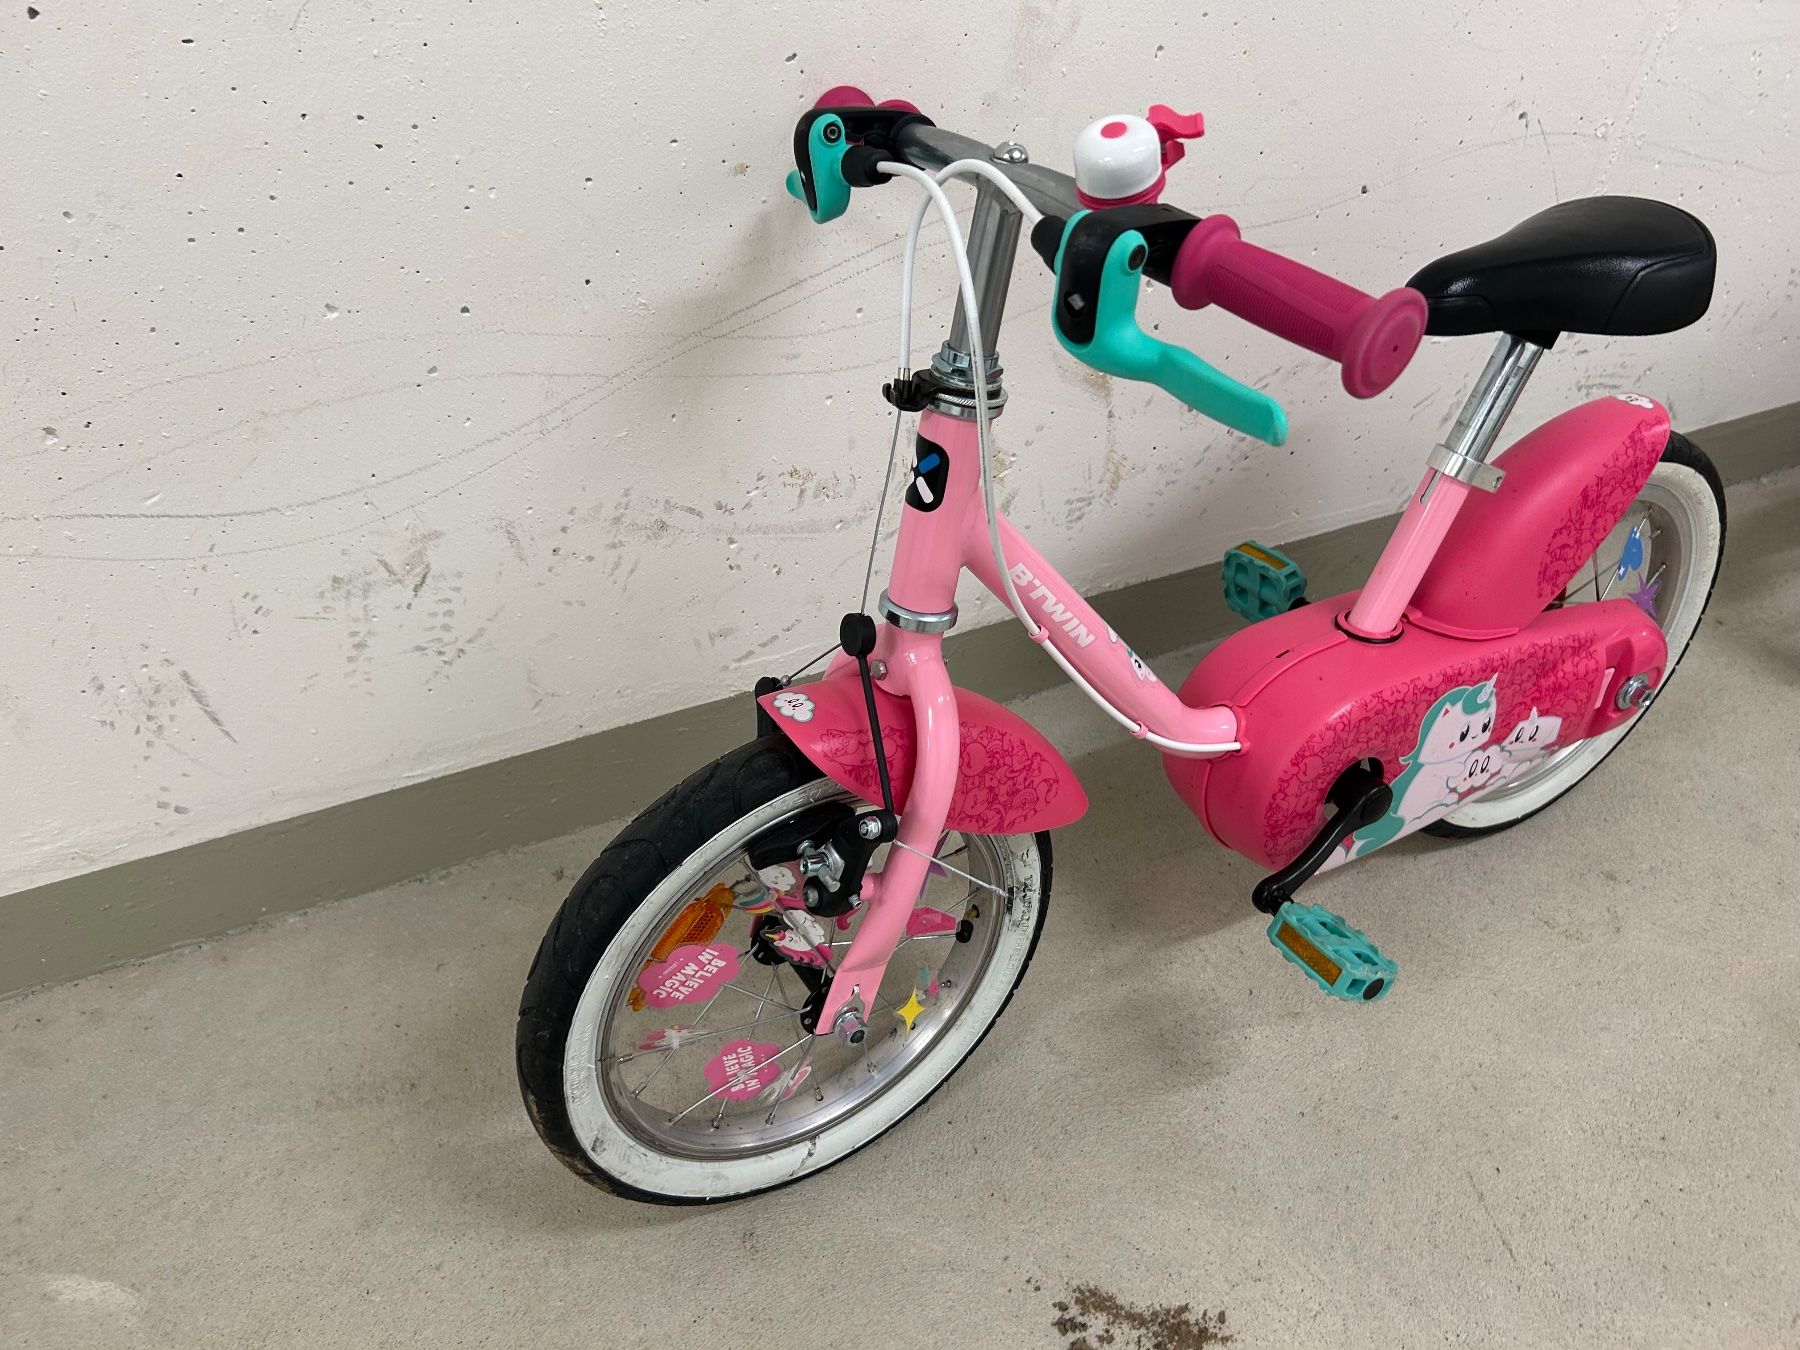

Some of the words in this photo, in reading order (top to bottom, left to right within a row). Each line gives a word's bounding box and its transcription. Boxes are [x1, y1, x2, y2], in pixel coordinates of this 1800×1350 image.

[1009, 563, 1096, 648] B'TWIN
[698, 948, 719, 964] IN
[652, 962, 699, 998] MAGIC
[671, 959, 727, 1000] BELIEVE
[745, 1079, 760, 1091] IN
